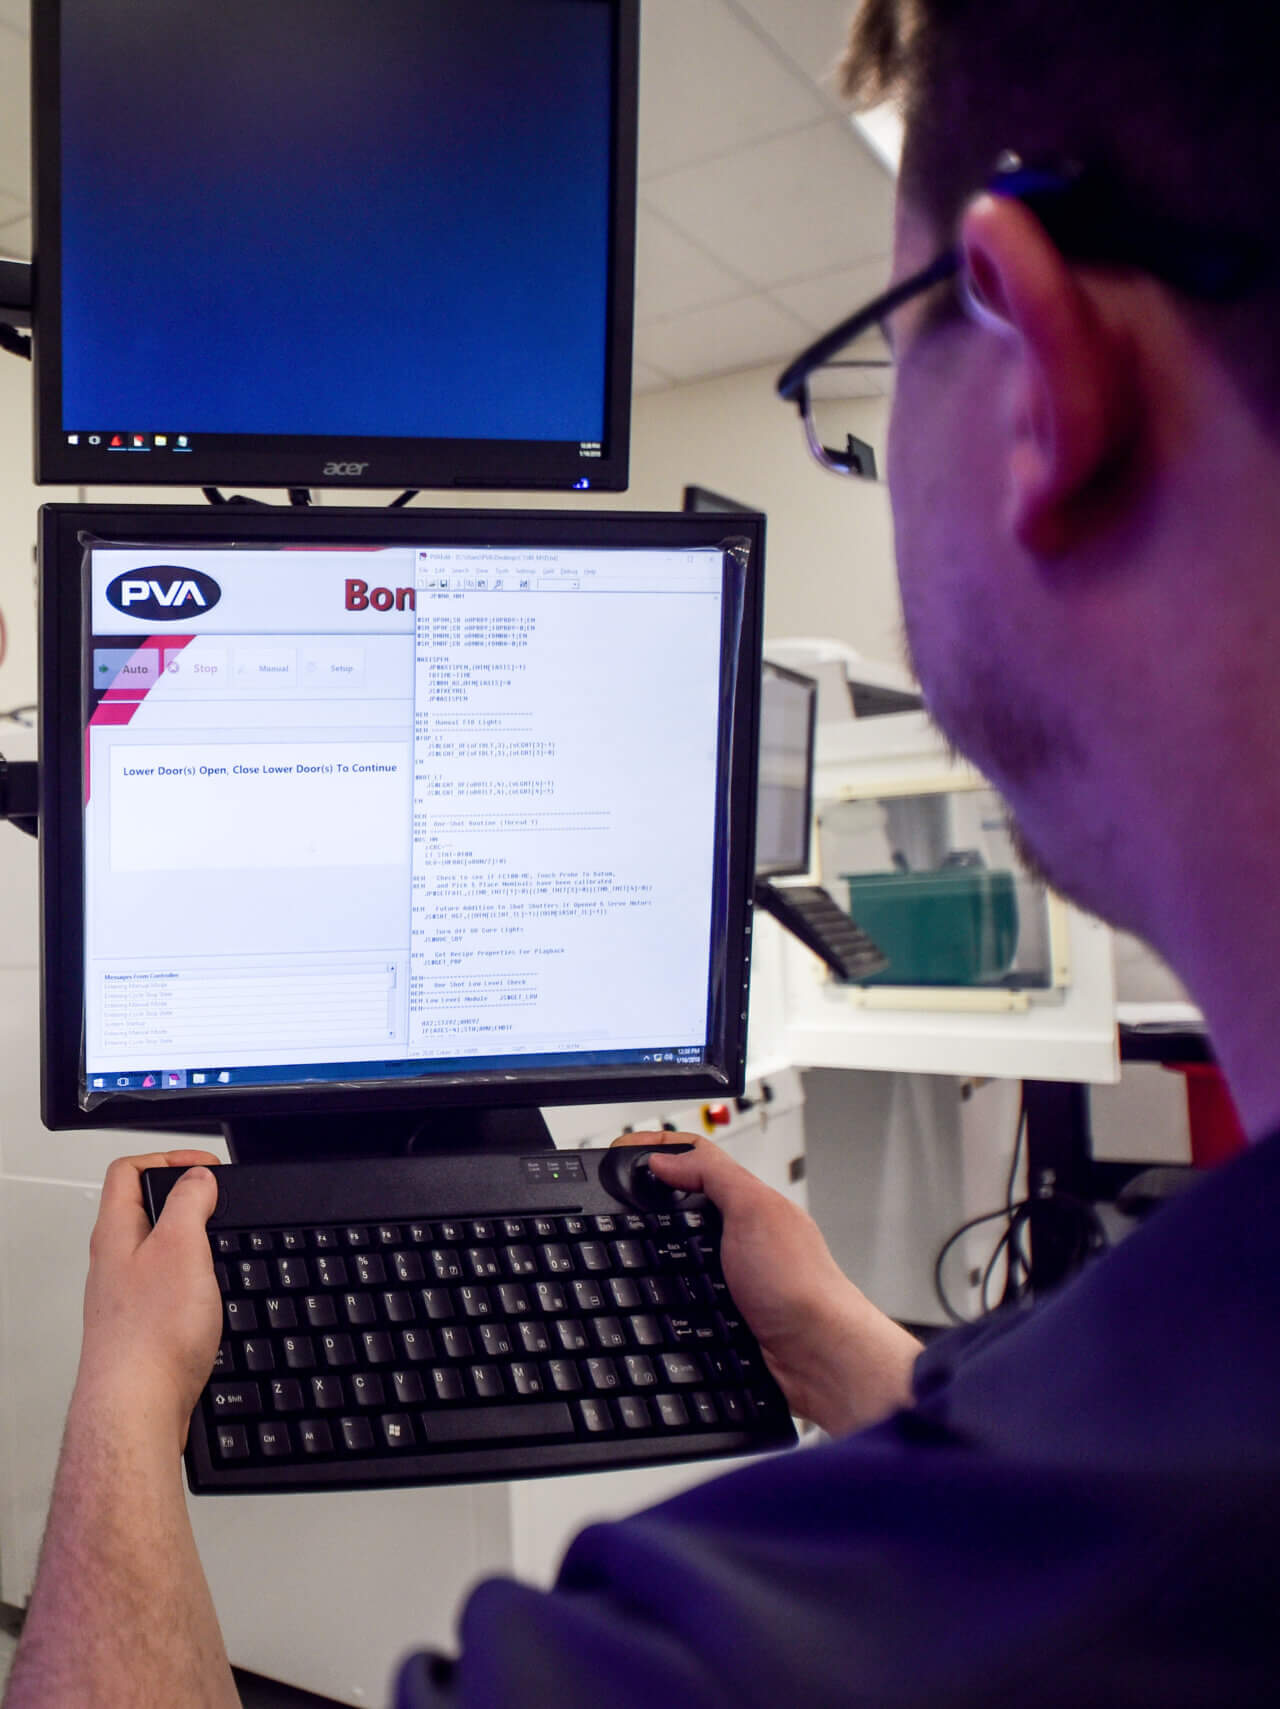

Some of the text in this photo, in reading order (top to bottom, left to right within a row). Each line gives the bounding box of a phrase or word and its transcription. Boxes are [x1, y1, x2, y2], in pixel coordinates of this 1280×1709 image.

[323, 462, 369, 475] acer
[121, 580, 207, 606] PVA
[122, 664, 148, 674] Auto
[193, 663, 218, 674] Stop
[259, 664, 288, 672] Manual
[123, 767, 154, 776] Lower
[158, 766, 196, 776] Door(s)
[232, 765, 260, 774] Close
[263, 765, 293, 774] Lower
[296, 764, 333, 775] Door(s)
[336, 764, 349, 773] To
[352, 763, 398, 773] Continue
[386, 1294, 394, 1303] T
[424, 1291, 432, 1301] Y
[463, 1288, 471, 1299] U
[270, 1300, 279, 1310] W
[308, 1298, 316, 1308] E
[348, 1296, 356, 1305] R
[445, 1330, 453, 1340] H
[522, 1326, 530, 1335] K
[326, 1338, 334, 1348] D
[406, 1333, 415, 1343] G
[246, 1343, 254, 1353] A
[287, 1341, 295, 1350] S
[435, 1372, 443, 1382] B
[475, 1370, 483, 1379] N
[515, 1368, 523, 1377] M
[315, 1380, 324, 1390] X
[356, 1378, 364, 1388] C
[274, 1384, 282, 1393] Z
